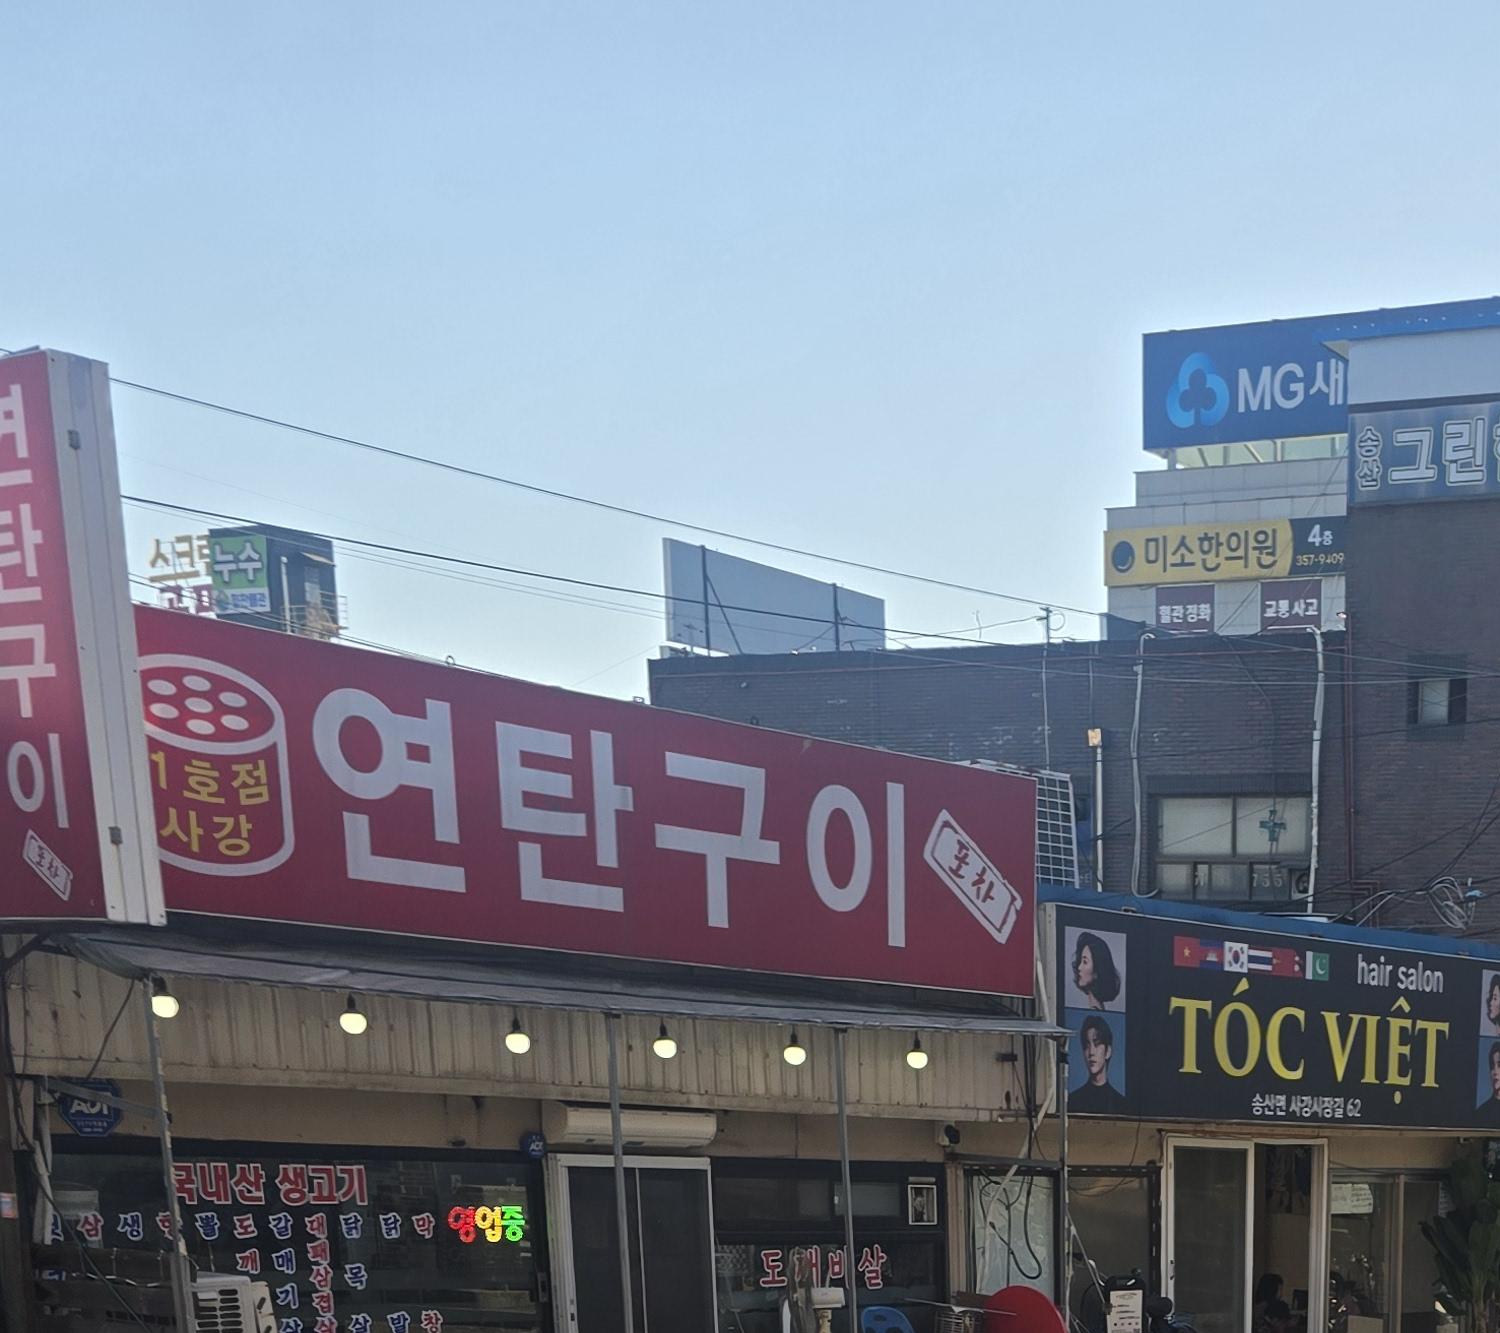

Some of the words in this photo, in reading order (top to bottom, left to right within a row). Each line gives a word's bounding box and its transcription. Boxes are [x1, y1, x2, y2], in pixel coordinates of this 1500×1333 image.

[1356, 426, 1382, 491] 송산
[1144, 528, 1278, 573] 미소한의원
[1307, 524, 1333, 547] 4층
[213, 541, 263, 583] 누수
[1263, 598, 1319, 618] 교통사고
[160, 807, 253, 857] 사강
[312, 687, 905, 948] 연탄구이
[1357, 954, 1391, 988] hair
[1397, 957, 1444, 994] salon
[1169, 977, 1305, 1081] TÓC
[1320, 997, 1449, 1105] VIỆT
[1251, 1092, 1287, 1117] 송산면
[1346, 1098, 1362, 1118] 62
[276, 1164, 368, 1206] 생고기
[447, 1205, 525, 1243] 영업중
